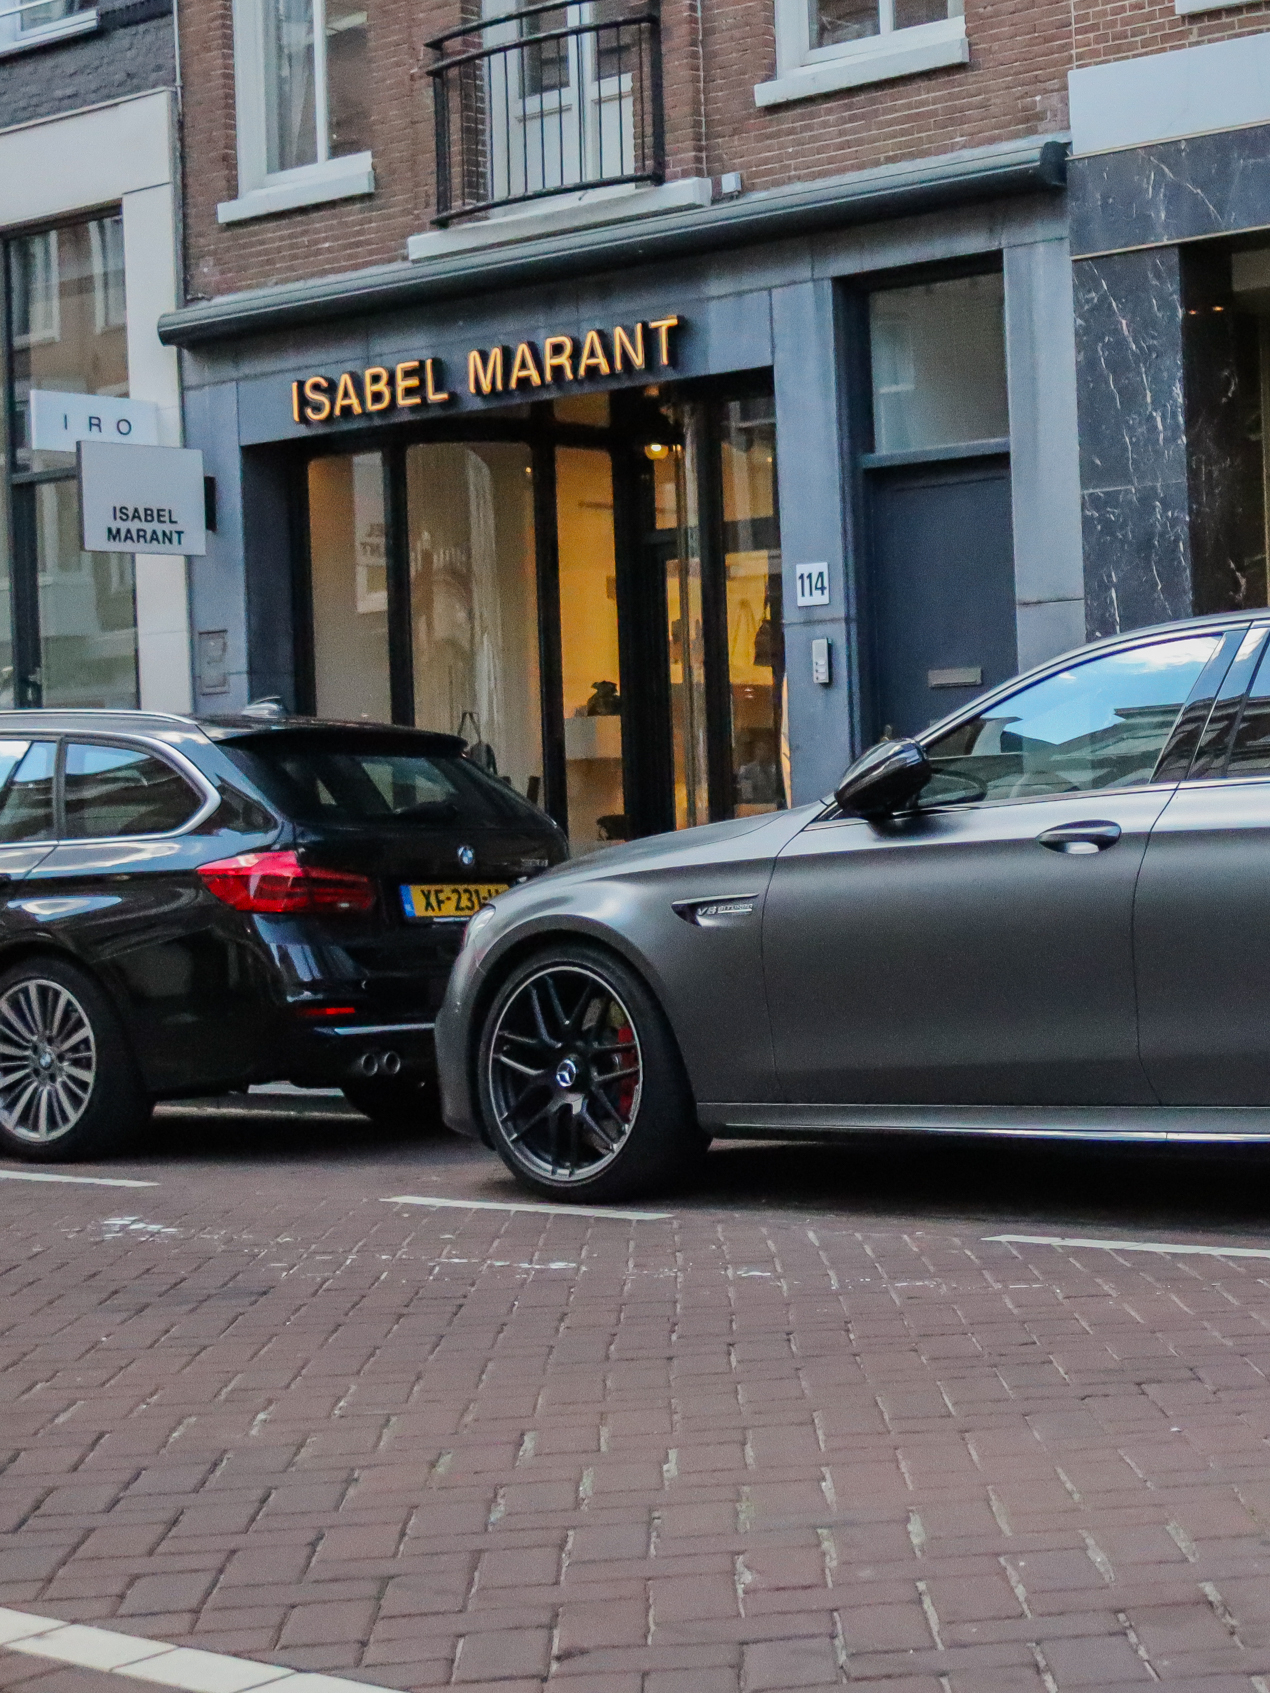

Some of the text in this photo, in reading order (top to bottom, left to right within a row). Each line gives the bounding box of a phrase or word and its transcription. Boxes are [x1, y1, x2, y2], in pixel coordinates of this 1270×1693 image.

[291, 315, 679, 423] ISABEL MARANT
[63, 414, 132, 436] IRO
[113, 506, 178, 525] ISABEL
[106, 526, 185, 546] MARANT
[798, 571, 828, 598] 114
